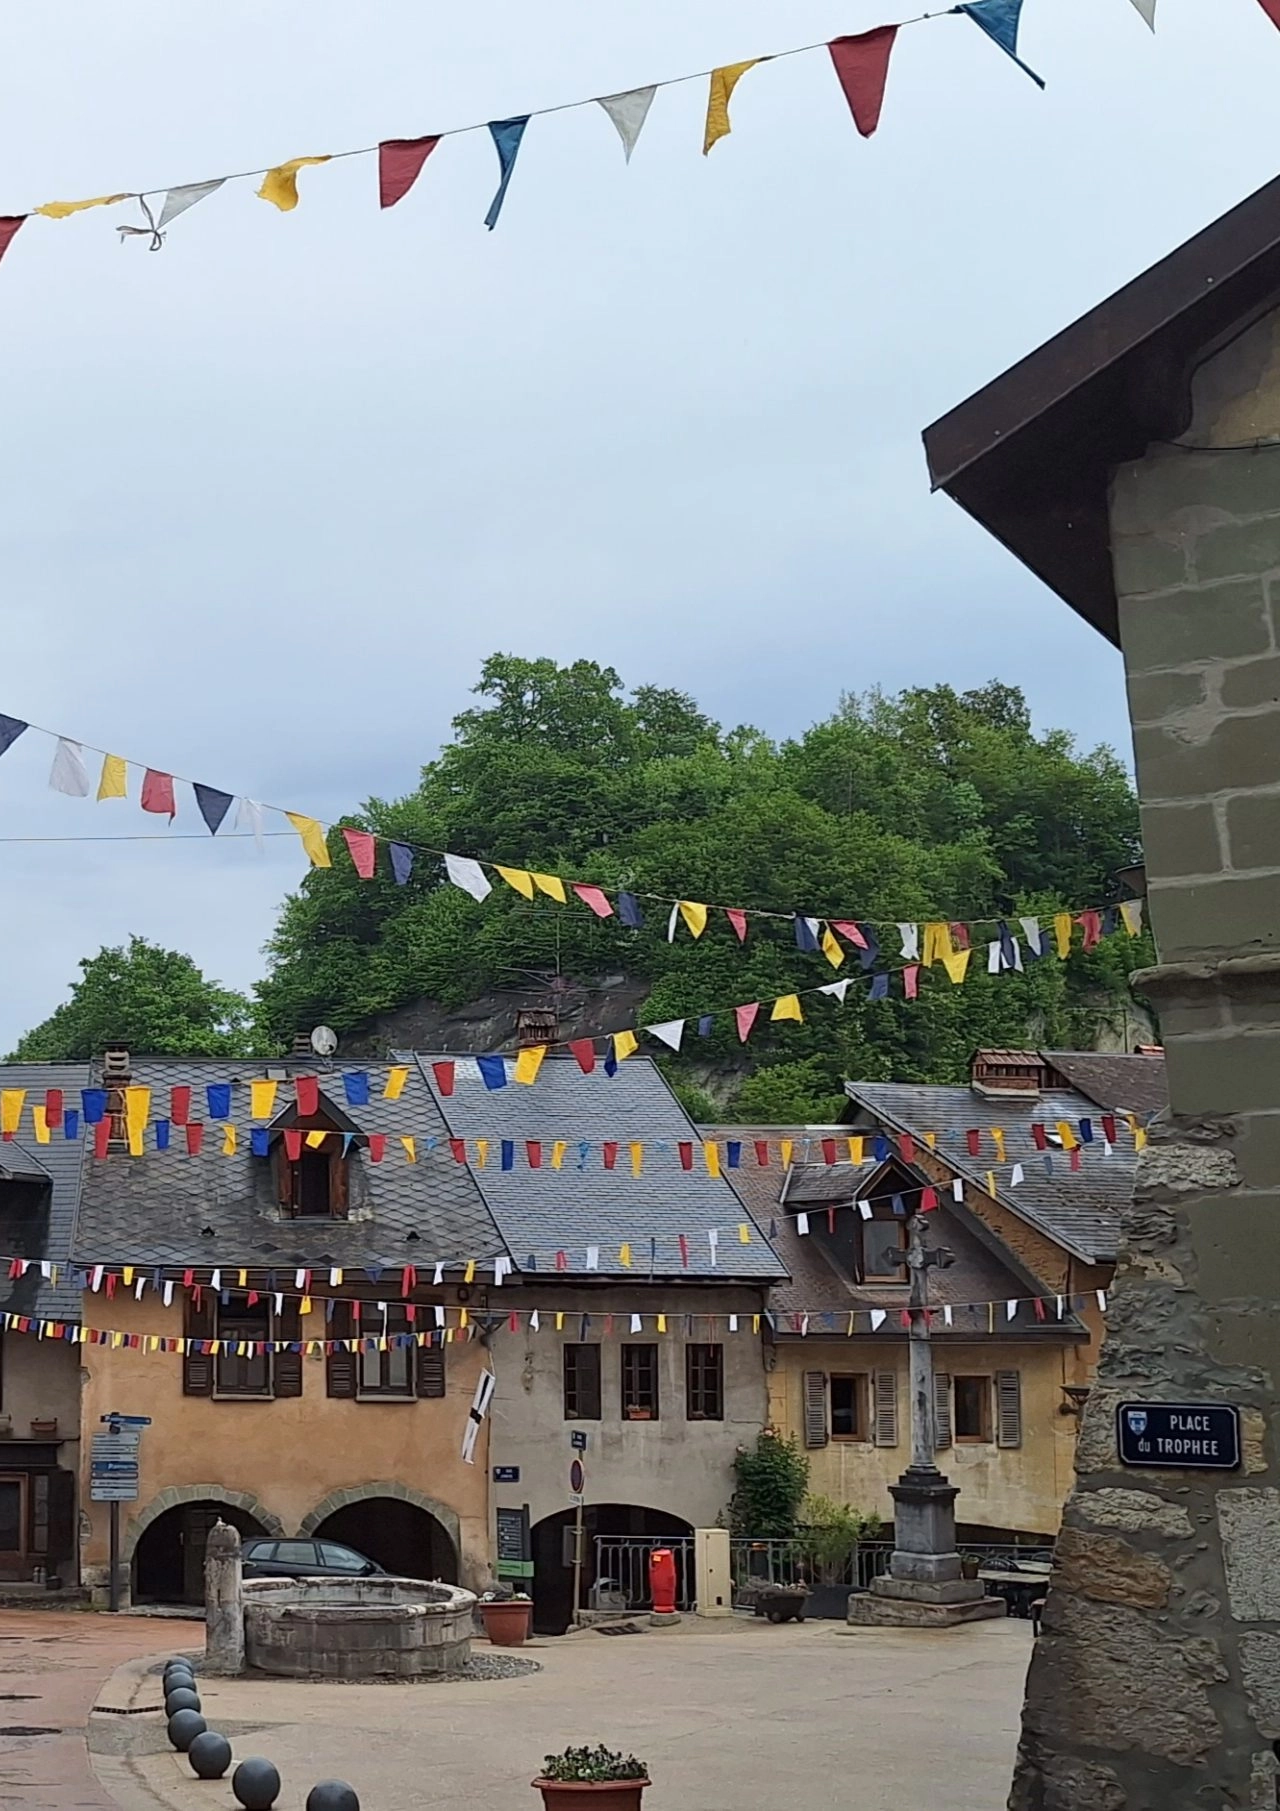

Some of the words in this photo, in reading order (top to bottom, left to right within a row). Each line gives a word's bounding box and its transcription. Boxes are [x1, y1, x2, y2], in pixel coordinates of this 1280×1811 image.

[1169, 1414, 1211, 1431] PLACE
[1138, 1437, 1151, 1453] du
[1156, 1437, 1219, 1456] TROPHEE
